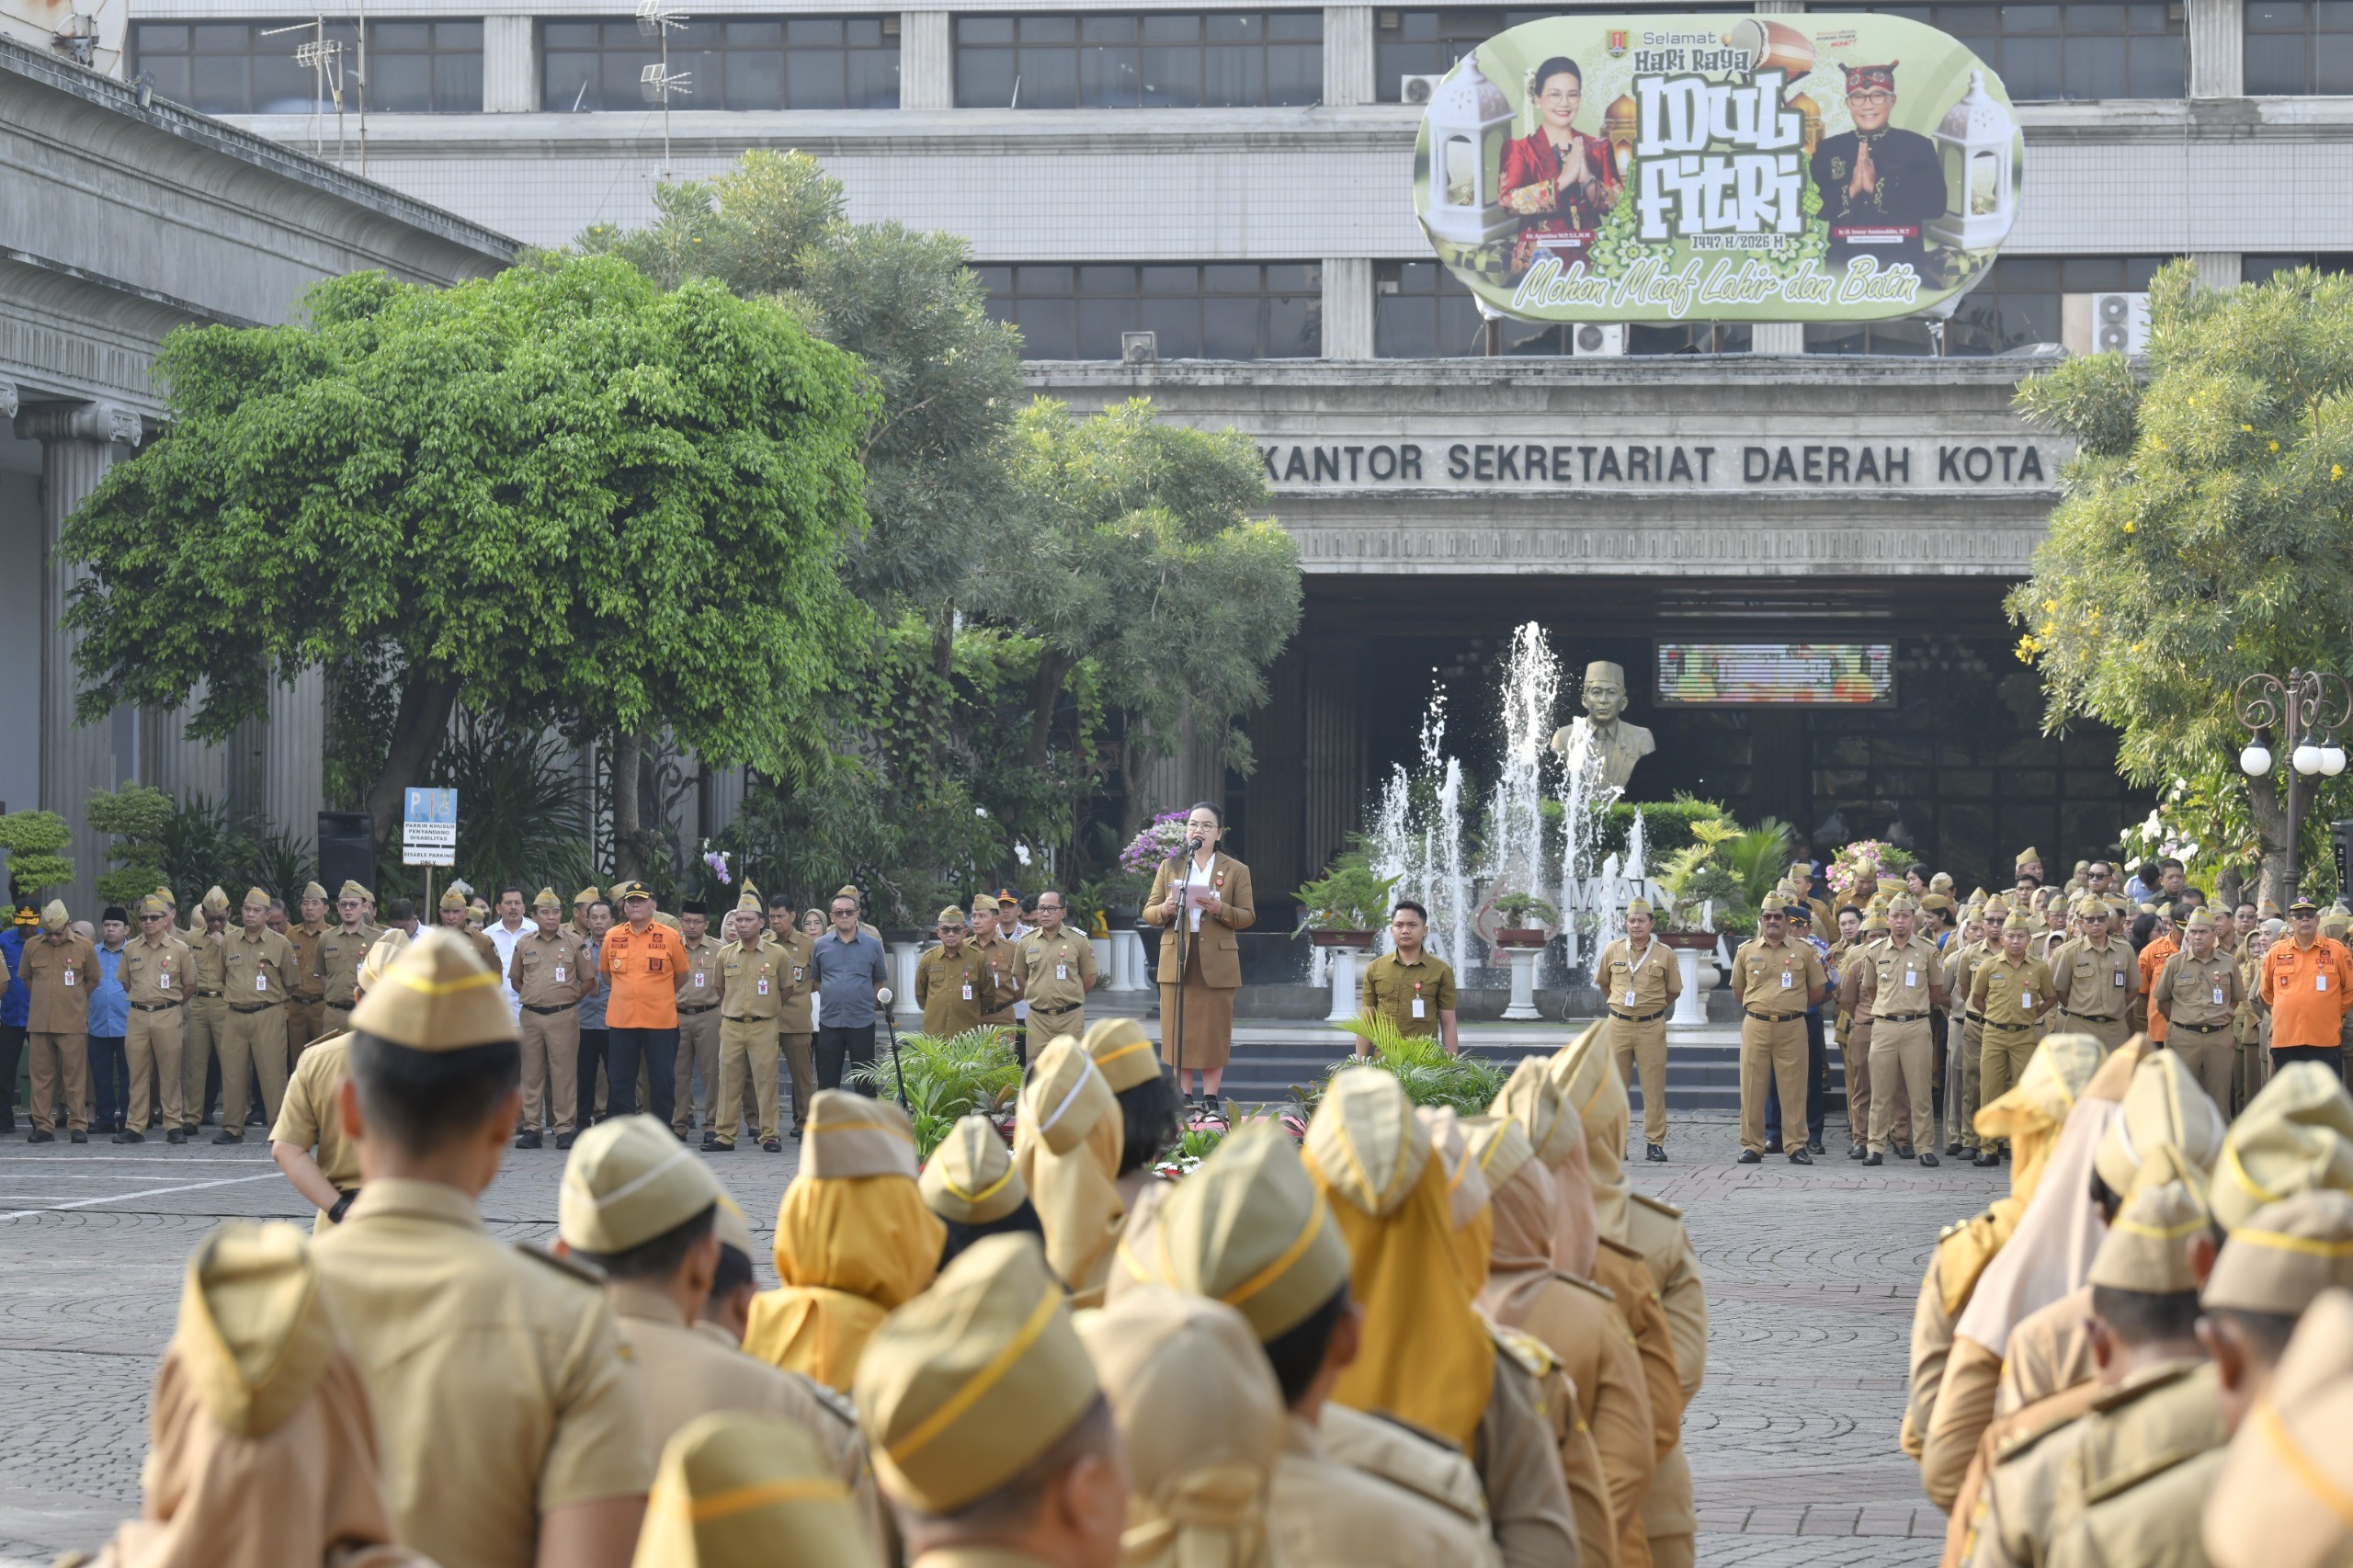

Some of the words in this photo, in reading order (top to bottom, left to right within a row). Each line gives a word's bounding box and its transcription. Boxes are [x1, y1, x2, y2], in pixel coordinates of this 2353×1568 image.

[1643, 31, 1716, 45] Selamat
[1692, 235, 1720, 249] 1447
[1725, 235, 1769, 249] H/2026
[1773, 235, 1785, 248] M
[1516, 260, 1605, 306] Mohon
[1615, 260, 1698, 315] Maaf
[1701, 259, 1778, 303] Lahir
[1786, 260, 1831, 302] dan
[1841, 257, 1918, 303] Batin
[1258, 445, 1422, 482] KANTOR
[1449, 444, 1715, 483] SEKRETARIAT
[1743, 446, 1910, 483] DAERAH
[1938, 446, 2044, 483] KOTA
